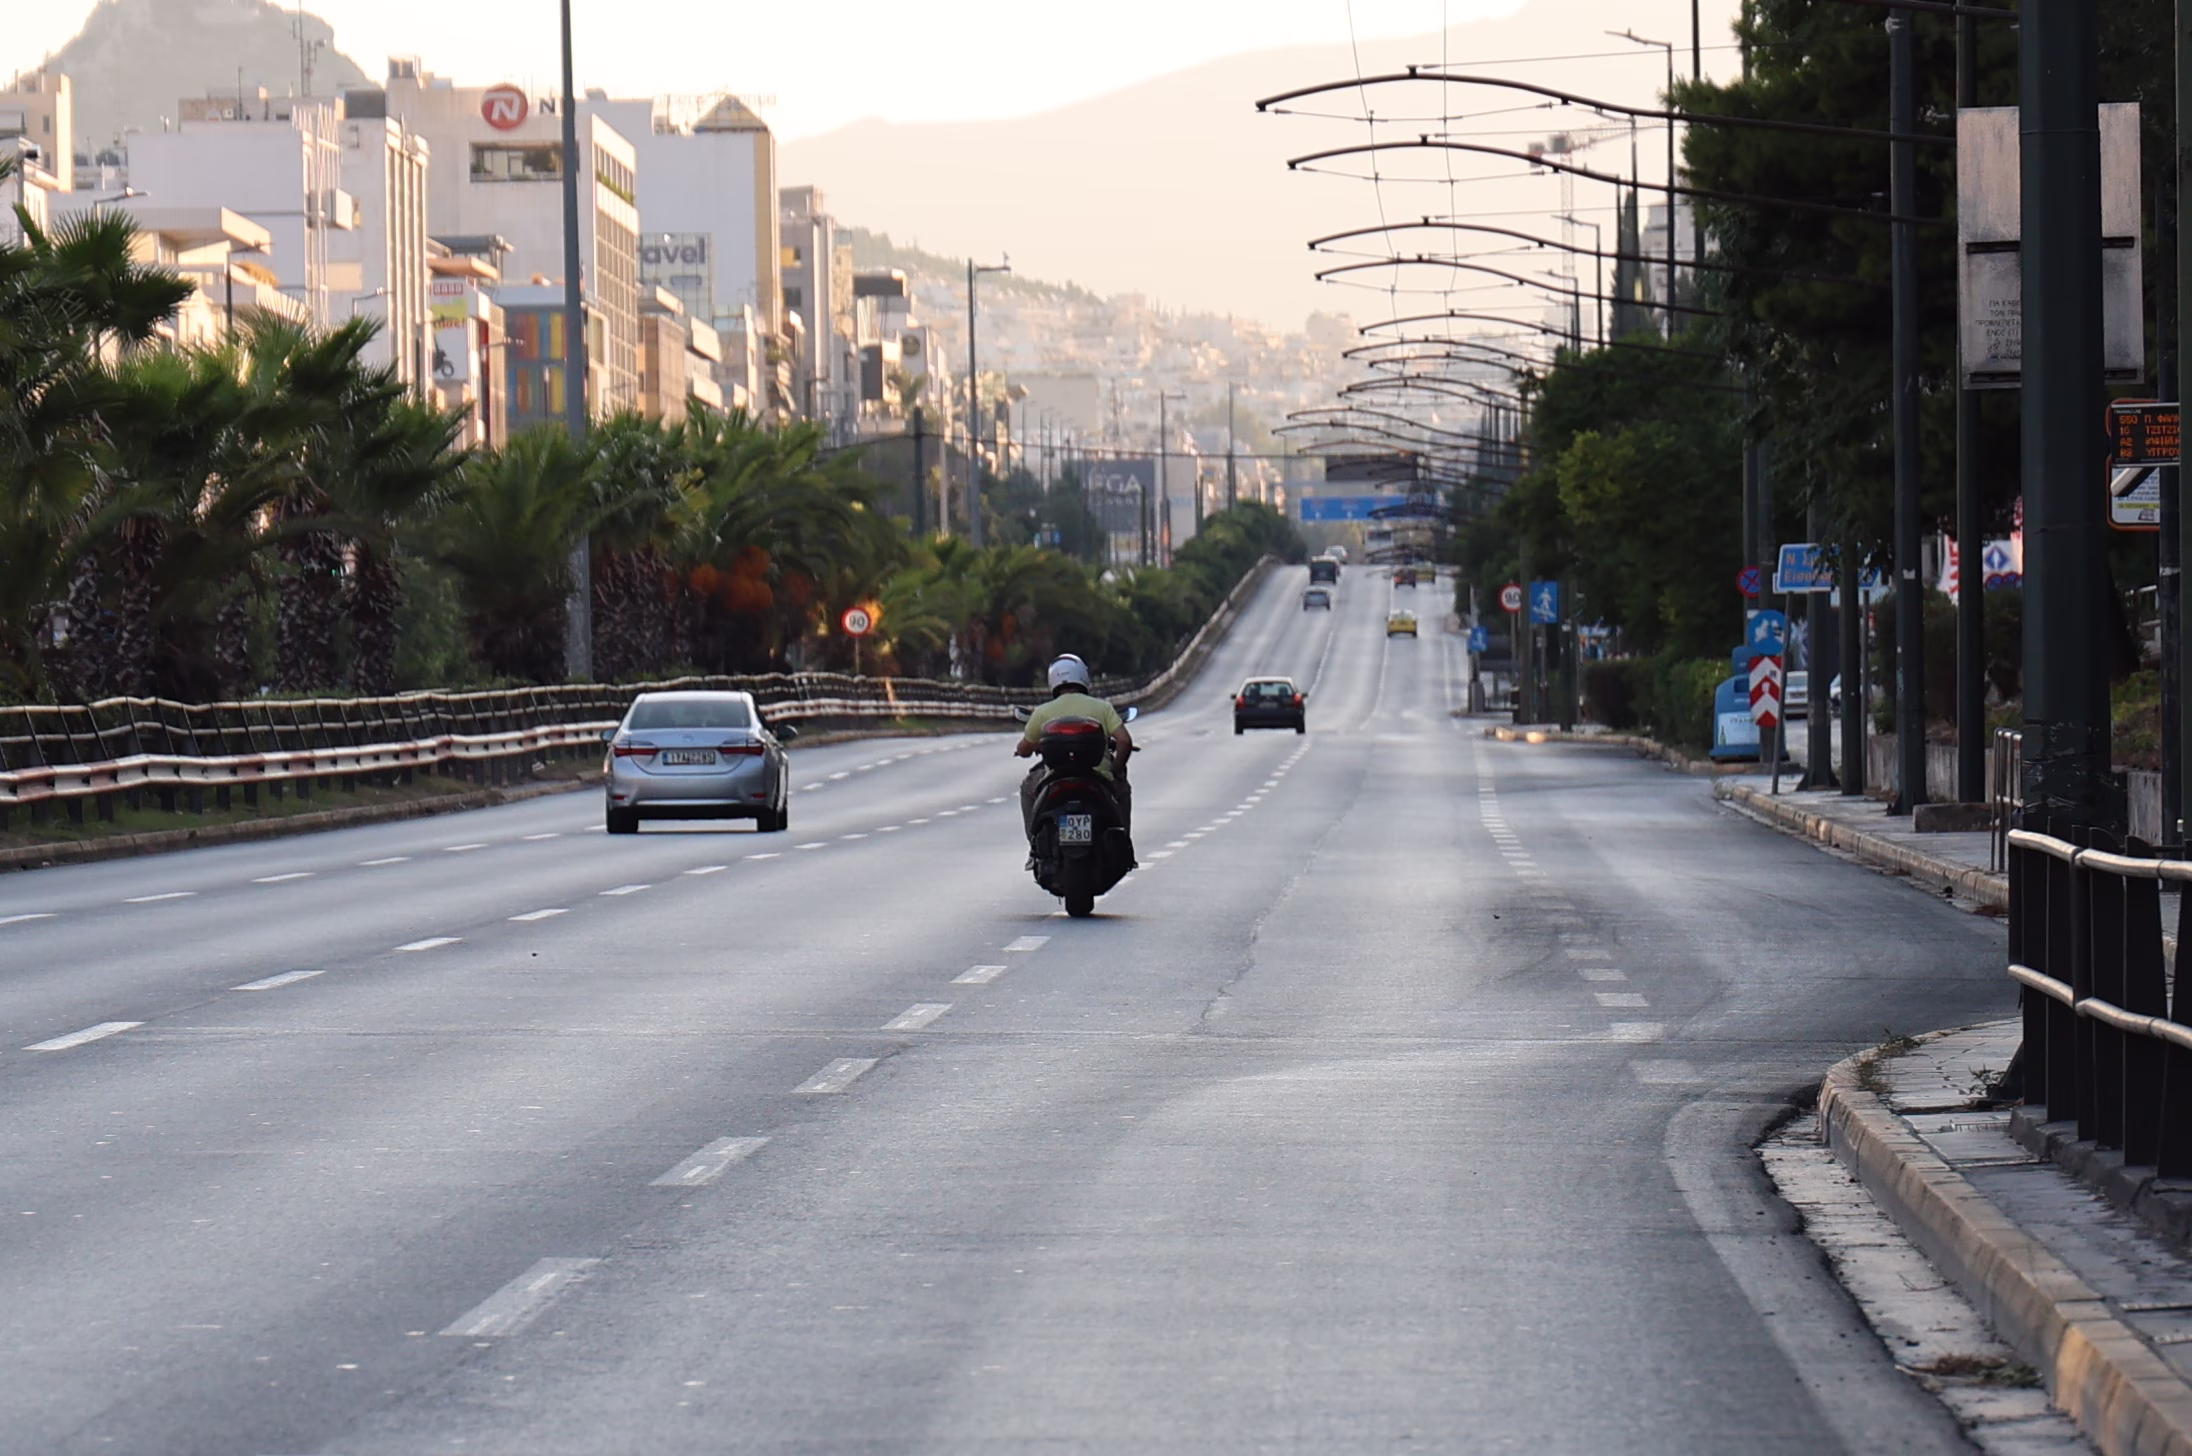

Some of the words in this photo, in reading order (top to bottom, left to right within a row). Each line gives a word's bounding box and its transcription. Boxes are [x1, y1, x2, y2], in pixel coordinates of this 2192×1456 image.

[638, 237, 705, 264] avel
[849, 614, 866, 628] 90
[1067, 829, 1090, 840] 280
